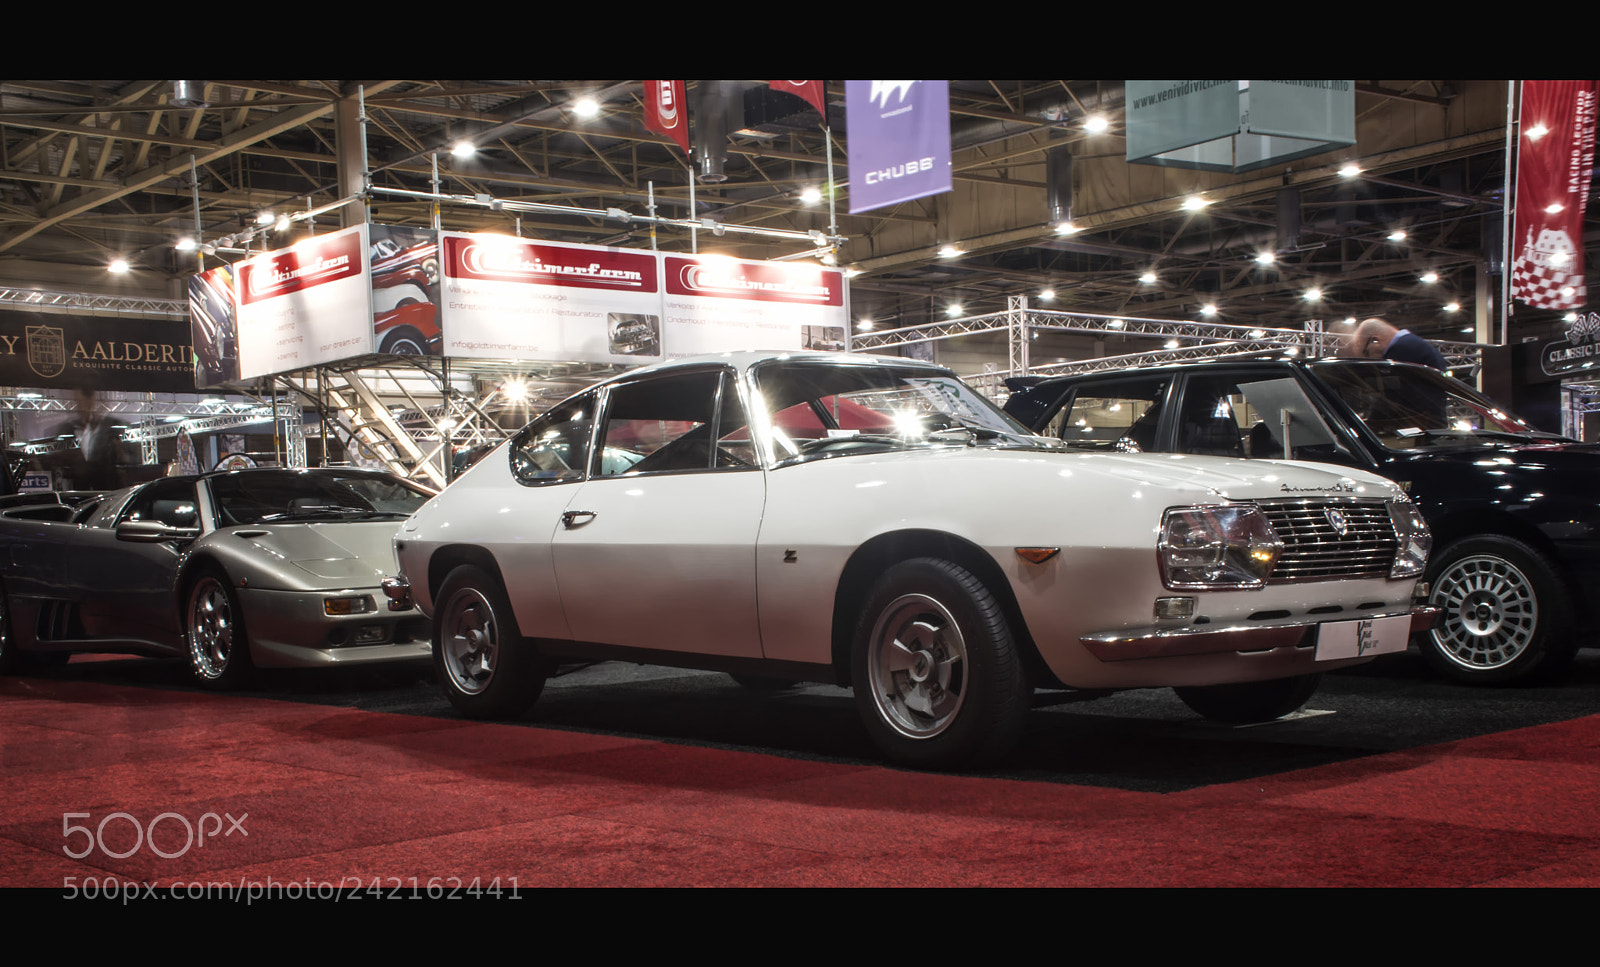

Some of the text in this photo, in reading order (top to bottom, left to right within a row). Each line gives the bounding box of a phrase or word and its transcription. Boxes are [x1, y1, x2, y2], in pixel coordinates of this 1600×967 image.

[1133, 80, 1233, 110] www.venividivici.
[1582, 91, 1596, 124] PARK
[1567, 91, 1586, 193] RACING LEGENDS
[1581, 127, 1595, 150] THE
[865, 158, 934, 185] CHUBB
[1581, 153, 1594, 166] IN
[482, 254, 641, 281] timerfarm
[0, 336, 20, 355] Y
[1548, 344, 1594, 364] CLASSIC
[20, 477, 48, 487] arts
